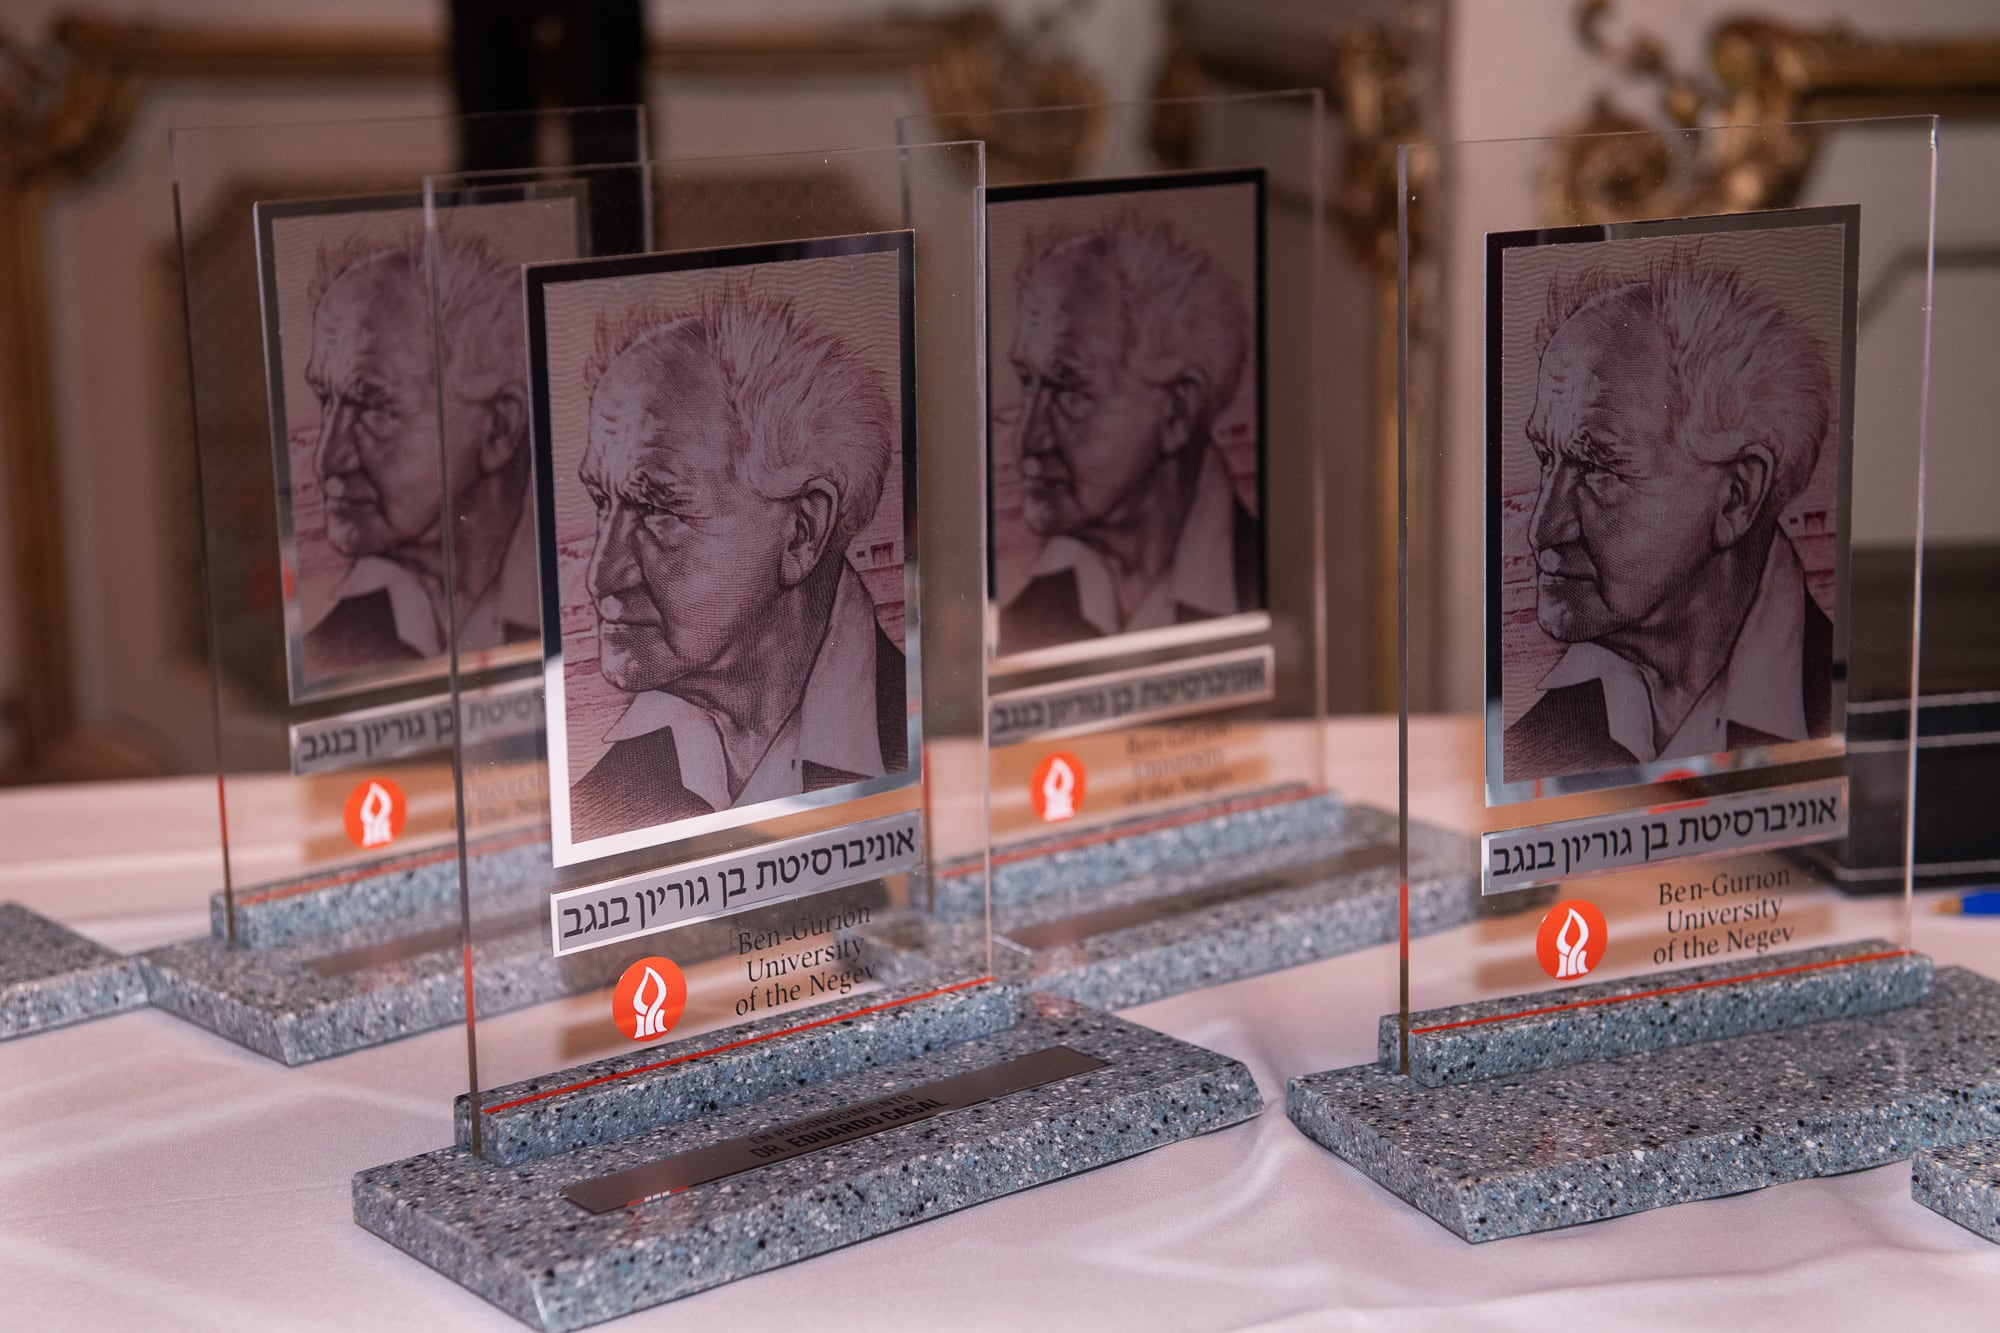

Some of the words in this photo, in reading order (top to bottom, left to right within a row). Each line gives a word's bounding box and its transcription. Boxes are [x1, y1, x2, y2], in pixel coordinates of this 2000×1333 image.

[301, 729, 358, 763] בנגב
[1642, 821, 1669, 862] בן
[1678, 795, 1838, 847] אוניברסיטת
[756, 826, 915, 891] אוניברסיטת
[1492, 839, 1556, 878] בנגב
[1561, 827, 1633, 877] גוריון
[635, 875, 711, 930] גוריון
[718, 866, 747, 908] בן
[1658, 867, 1791, 906] Ben-Gurion
[563, 896, 630, 939] בנגב
[737, 903, 871, 956] Ben-Gurion
[1666, 896, 1784, 934] University
[747, 935, 866, 983] University
[1653, 942, 1674, 965] of
[1683, 933, 1719, 959] the
[1727, 924, 1795, 957] Negev
[735, 990, 758, 1018] of
[766, 977, 801, 1009] the
[809, 961, 878, 998] Negev
[748, 1133, 773, 1145] EN
[750, 1143, 791, 1159] DR.
[786, 1114, 884, 1149] EDUARDO
[884, 1098, 950, 1122] CASAL
